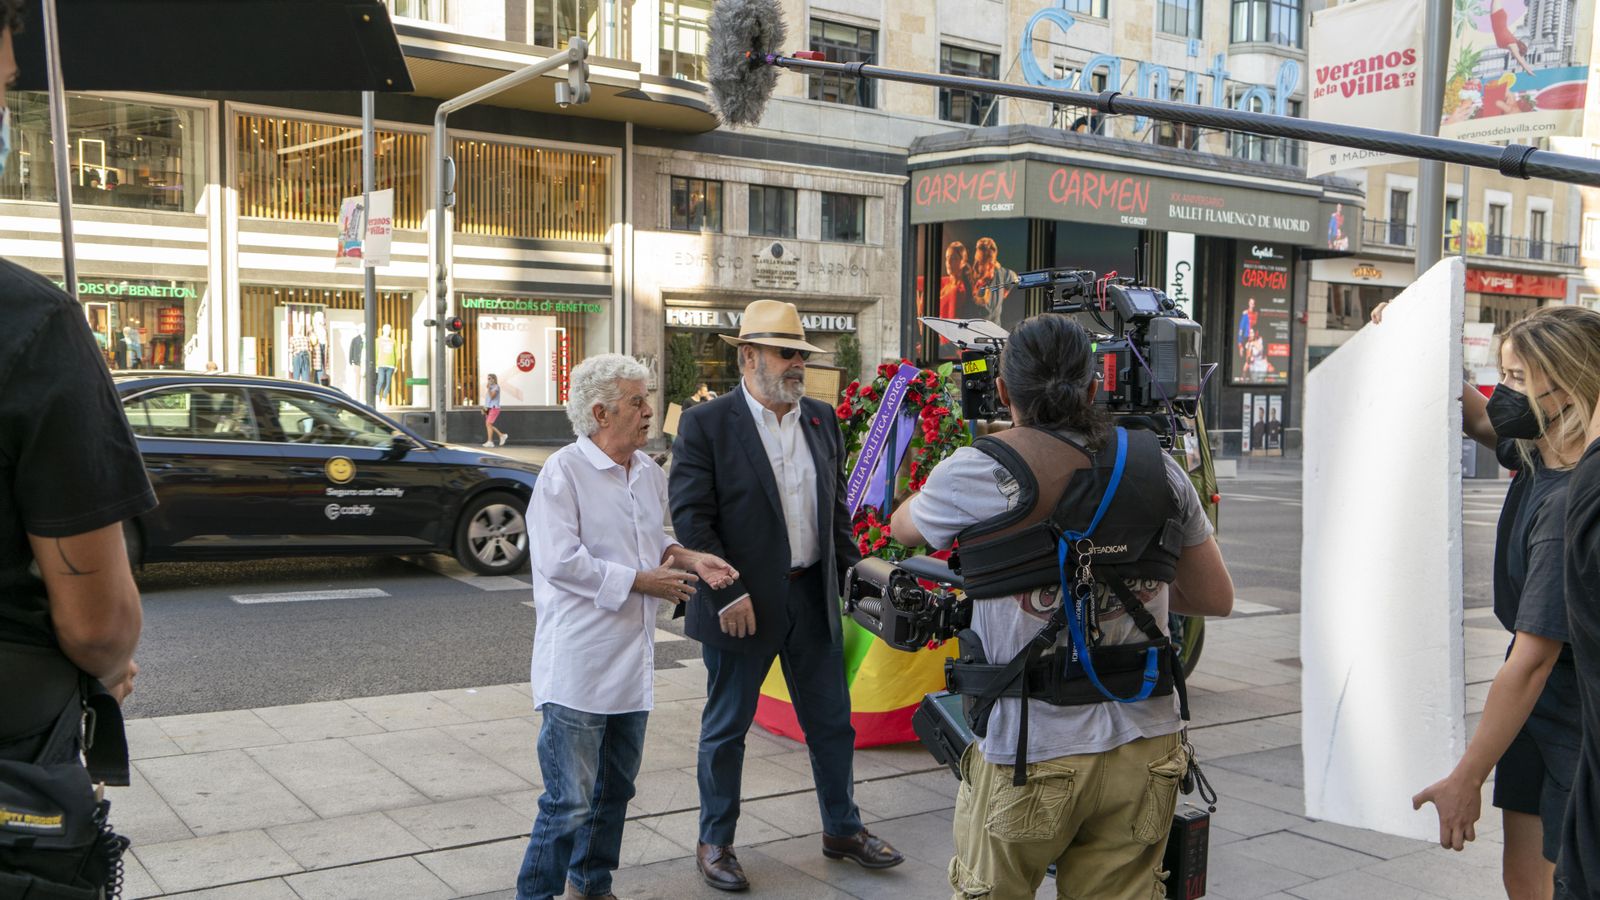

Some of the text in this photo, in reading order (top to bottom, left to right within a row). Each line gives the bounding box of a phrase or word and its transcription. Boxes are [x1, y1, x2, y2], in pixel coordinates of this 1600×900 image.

[1313, 87, 1325, 99] de
[1327, 84, 1338, 95] la
[915, 168, 1017, 207] CARMEN
[1049, 168, 1150, 214] CARMEN
[981, 204, 990, 212] DE
[1121, 215, 1128, 224] DE
[1169, 204, 1310, 233] BALLET FLAMENCO DE MADRID
[1242, 268, 1287, 290] CARMEN
[1480, 275, 1514, 289] VIPS
[108, 284, 127, 296] OF
[462, 298, 499, 309] UNITED
[500, 300, 538, 311] COLORS
[540, 301, 554, 311] OF
[666, 309, 724, 326] HOTEL
[801, 314, 857, 330] APITOL
[480, 322, 515, 331] UNITED
[375, 487, 405, 498] Cabify
[847, 466, 865, 506] AMILIA
[340, 504, 375, 516] cabify
[1087, 544, 1128, 555] STEADICAM
